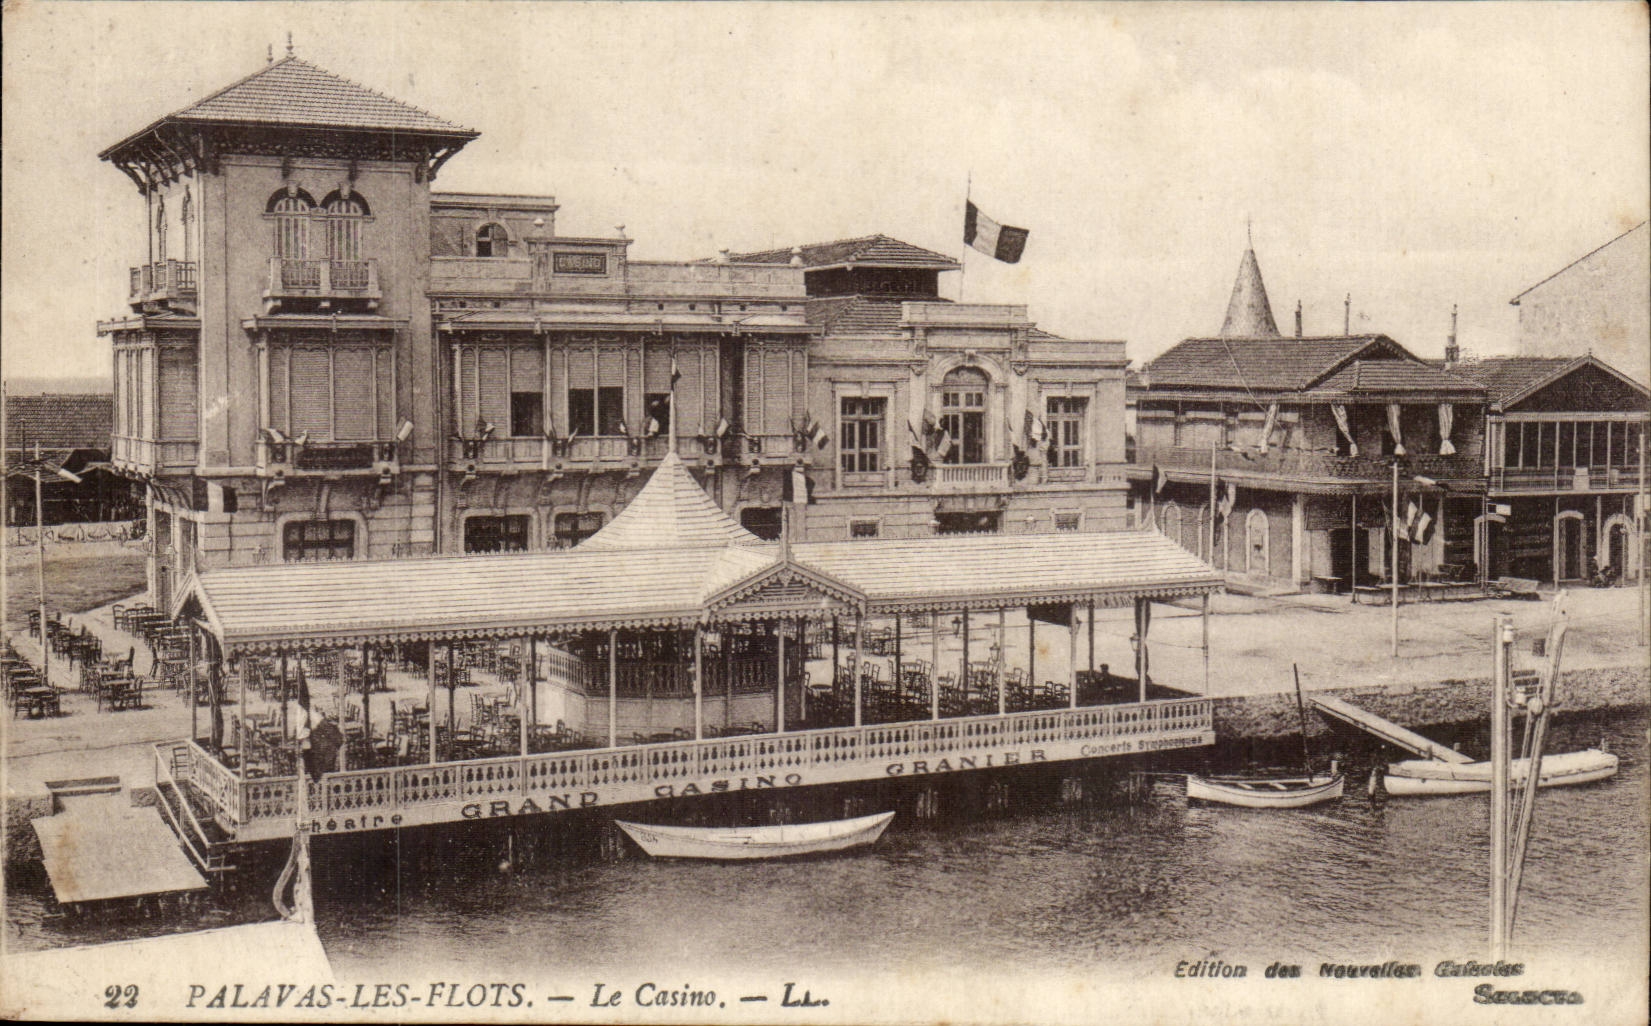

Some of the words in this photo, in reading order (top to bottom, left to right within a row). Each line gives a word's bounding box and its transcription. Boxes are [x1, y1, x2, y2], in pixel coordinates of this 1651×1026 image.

[461, 791, 599, 819] GRAND
[654, 773, 802, 798] CASINO
[886, 749, 1047, 777] GRANIER
